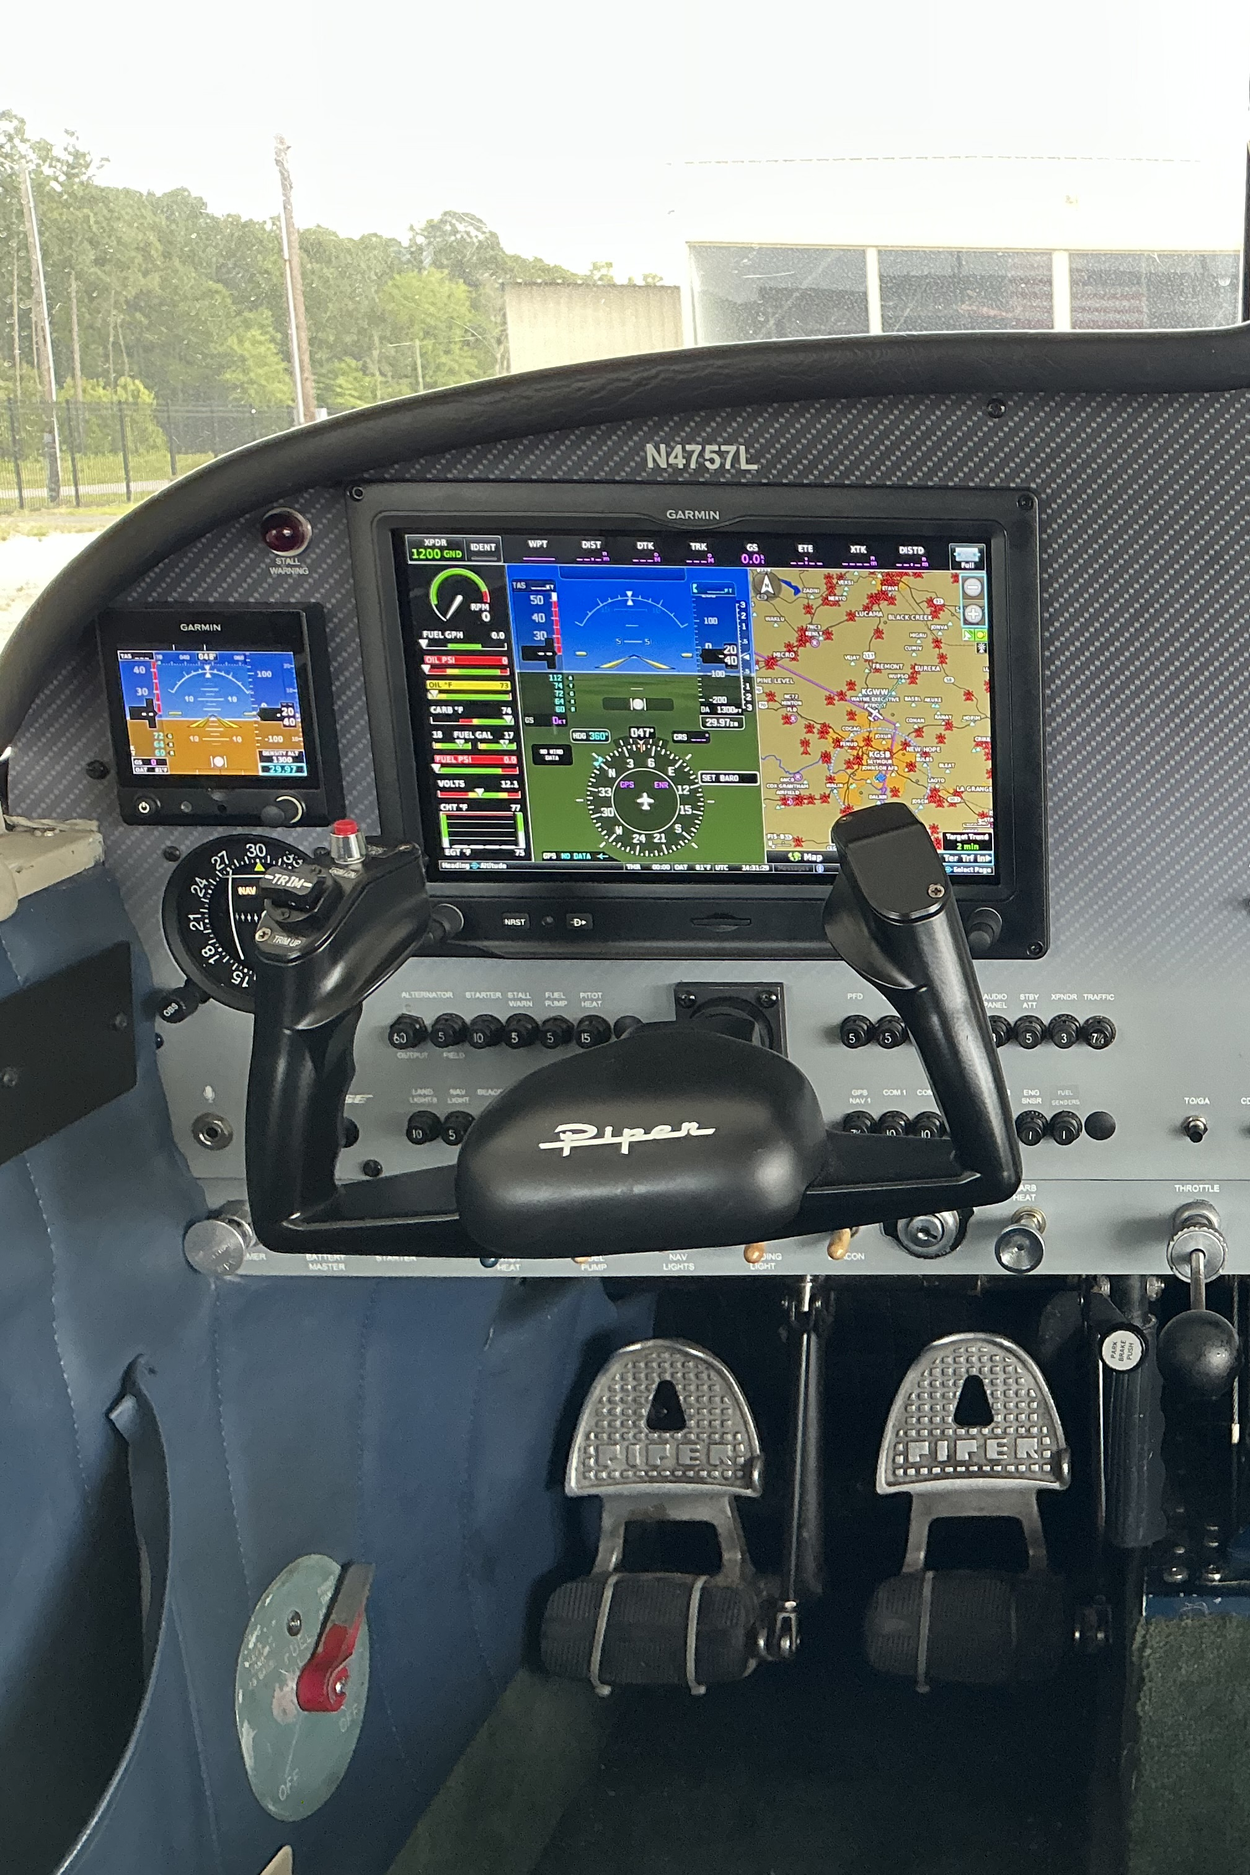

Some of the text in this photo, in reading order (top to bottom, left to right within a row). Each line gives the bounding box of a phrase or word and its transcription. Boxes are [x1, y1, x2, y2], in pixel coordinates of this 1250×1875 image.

[646, 443, 758, 470] N4757L
[666, 509, 720, 520] GARMIN
[470, 543, 496, 551] IDENT
[527, 540, 548, 548] WPT
[411, 549, 441, 559] 1200
[899, 547, 924, 555] DISTD
[275, 557, 301, 566] STALL
[269, 567, 309, 576] WARNING
[470, 603, 490, 611] RPM
[180, 622, 222, 632] GARMIN
[269, 765, 297, 774] 29.97
[437, 780, 465, 788] VOLTS
[246, 844, 266, 857] 30
[211, 851, 229, 870] 27
[803, 853, 823, 862] Map
[273, 872, 305, 887] TRIM
[401, 991, 453, 999] ALTERNATOR
[1019, 993, 1039, 1001] STBY
[1051, 993, 1077, 1001] XPNDR
[1083, 993, 1115, 1001] TRAFFIC
[1184, 1097, 1210, 1105] TO/GA
[538, 1121, 716, 1157] Piper
[1174, 1184, 1220, 1193] THROTTLE
[669, 1253, 687, 1261] NAV
[663, 1263, 695, 1271] LIGHTS
[1118, 1339, 1127, 1362] BRAKE
[1126, 1342, 1134, 1360] PUSH
[907, 1438, 1040, 1462] PIPER
[600, 1443, 734, 1468] PIPER
